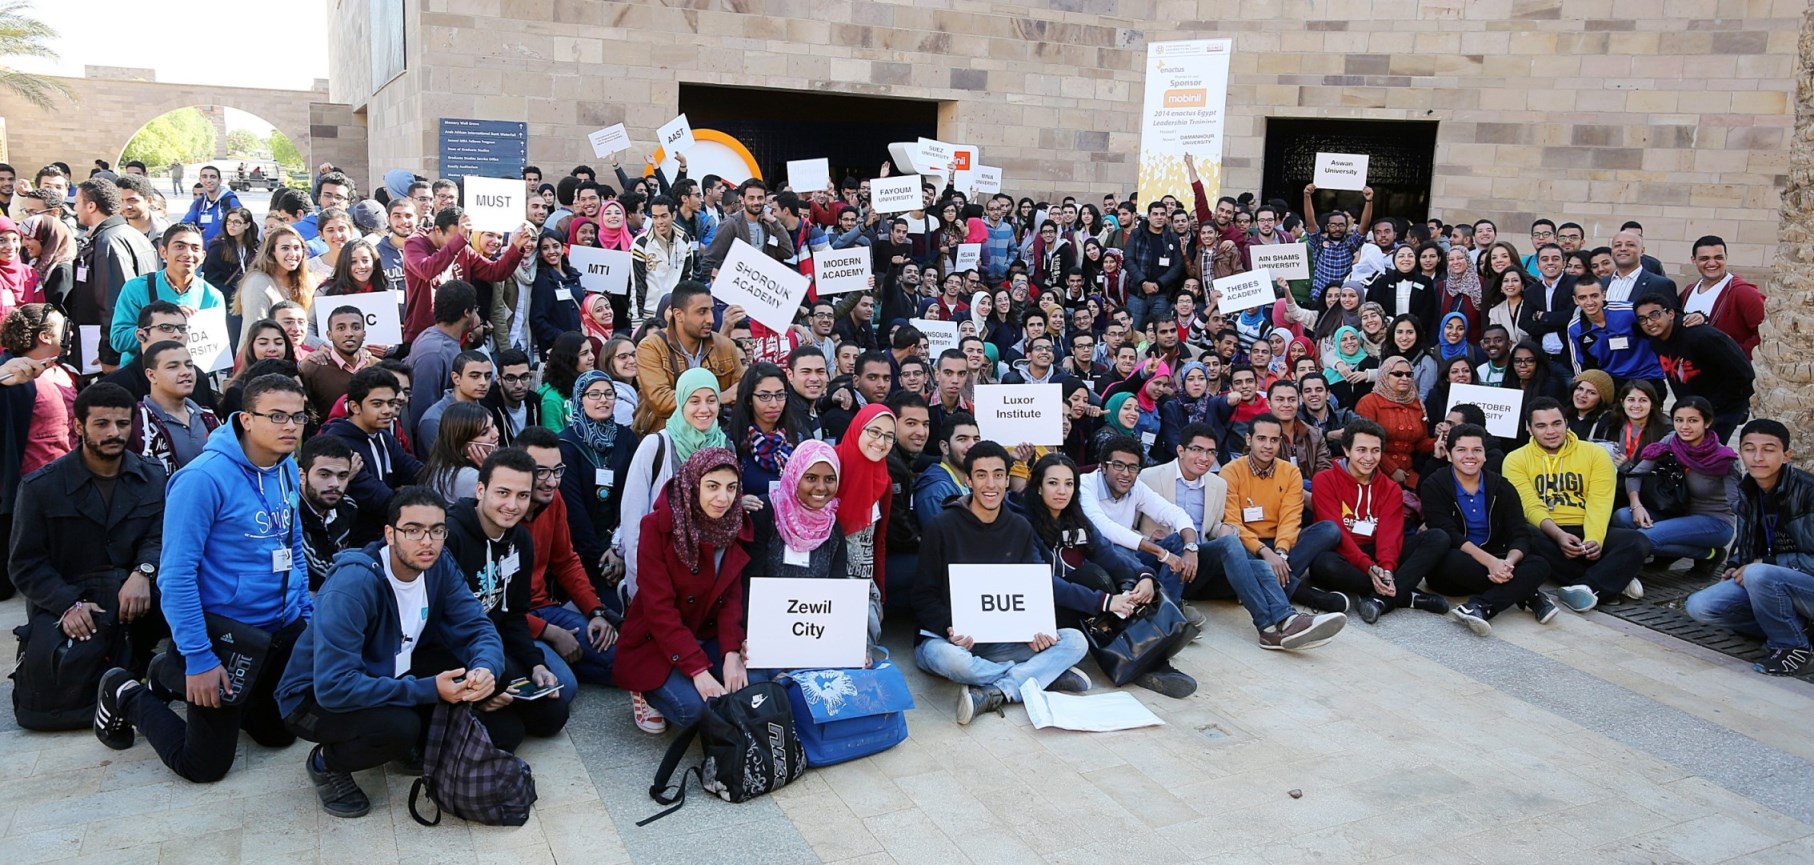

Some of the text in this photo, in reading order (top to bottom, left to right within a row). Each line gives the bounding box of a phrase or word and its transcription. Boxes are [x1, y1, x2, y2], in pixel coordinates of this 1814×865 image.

[1170, 80, 1202, 88] Sponsor
[1168, 93, 1202, 103] mobinil
[1197, 110, 1217, 118] Egypt
[668, 128, 684, 144] AAST
[921, 150, 949, 160] UNIVERSITY
[928, 145, 944, 153] SUEZ
[1324, 168, 1358, 176] University
[880, 186, 912, 196] FAYOUM
[476, 194, 512, 208] MUST
[878, 194, 914, 202] UNIVERSITY
[823, 256, 862, 268] MODERN
[1272, 254, 1300, 262] SHAMS
[588, 263, 610, 276] MTI
[822, 268, 865, 280] ACADEMY
[735, 261, 792, 300] SHOROUK
[1226, 280, 1260, 293] THEBES
[732, 277, 782, 309] ACADEMY
[1226, 288, 1262, 301] ACADEMY
[190, 343, 218, 356] RSITY
[1003, 396, 1034, 404] Luxor
[996, 409, 1042, 418] Institute
[786, 600, 832, 614] Zewil
[980, 594, 1026, 612] BUE
[792, 622, 825, 640] City
